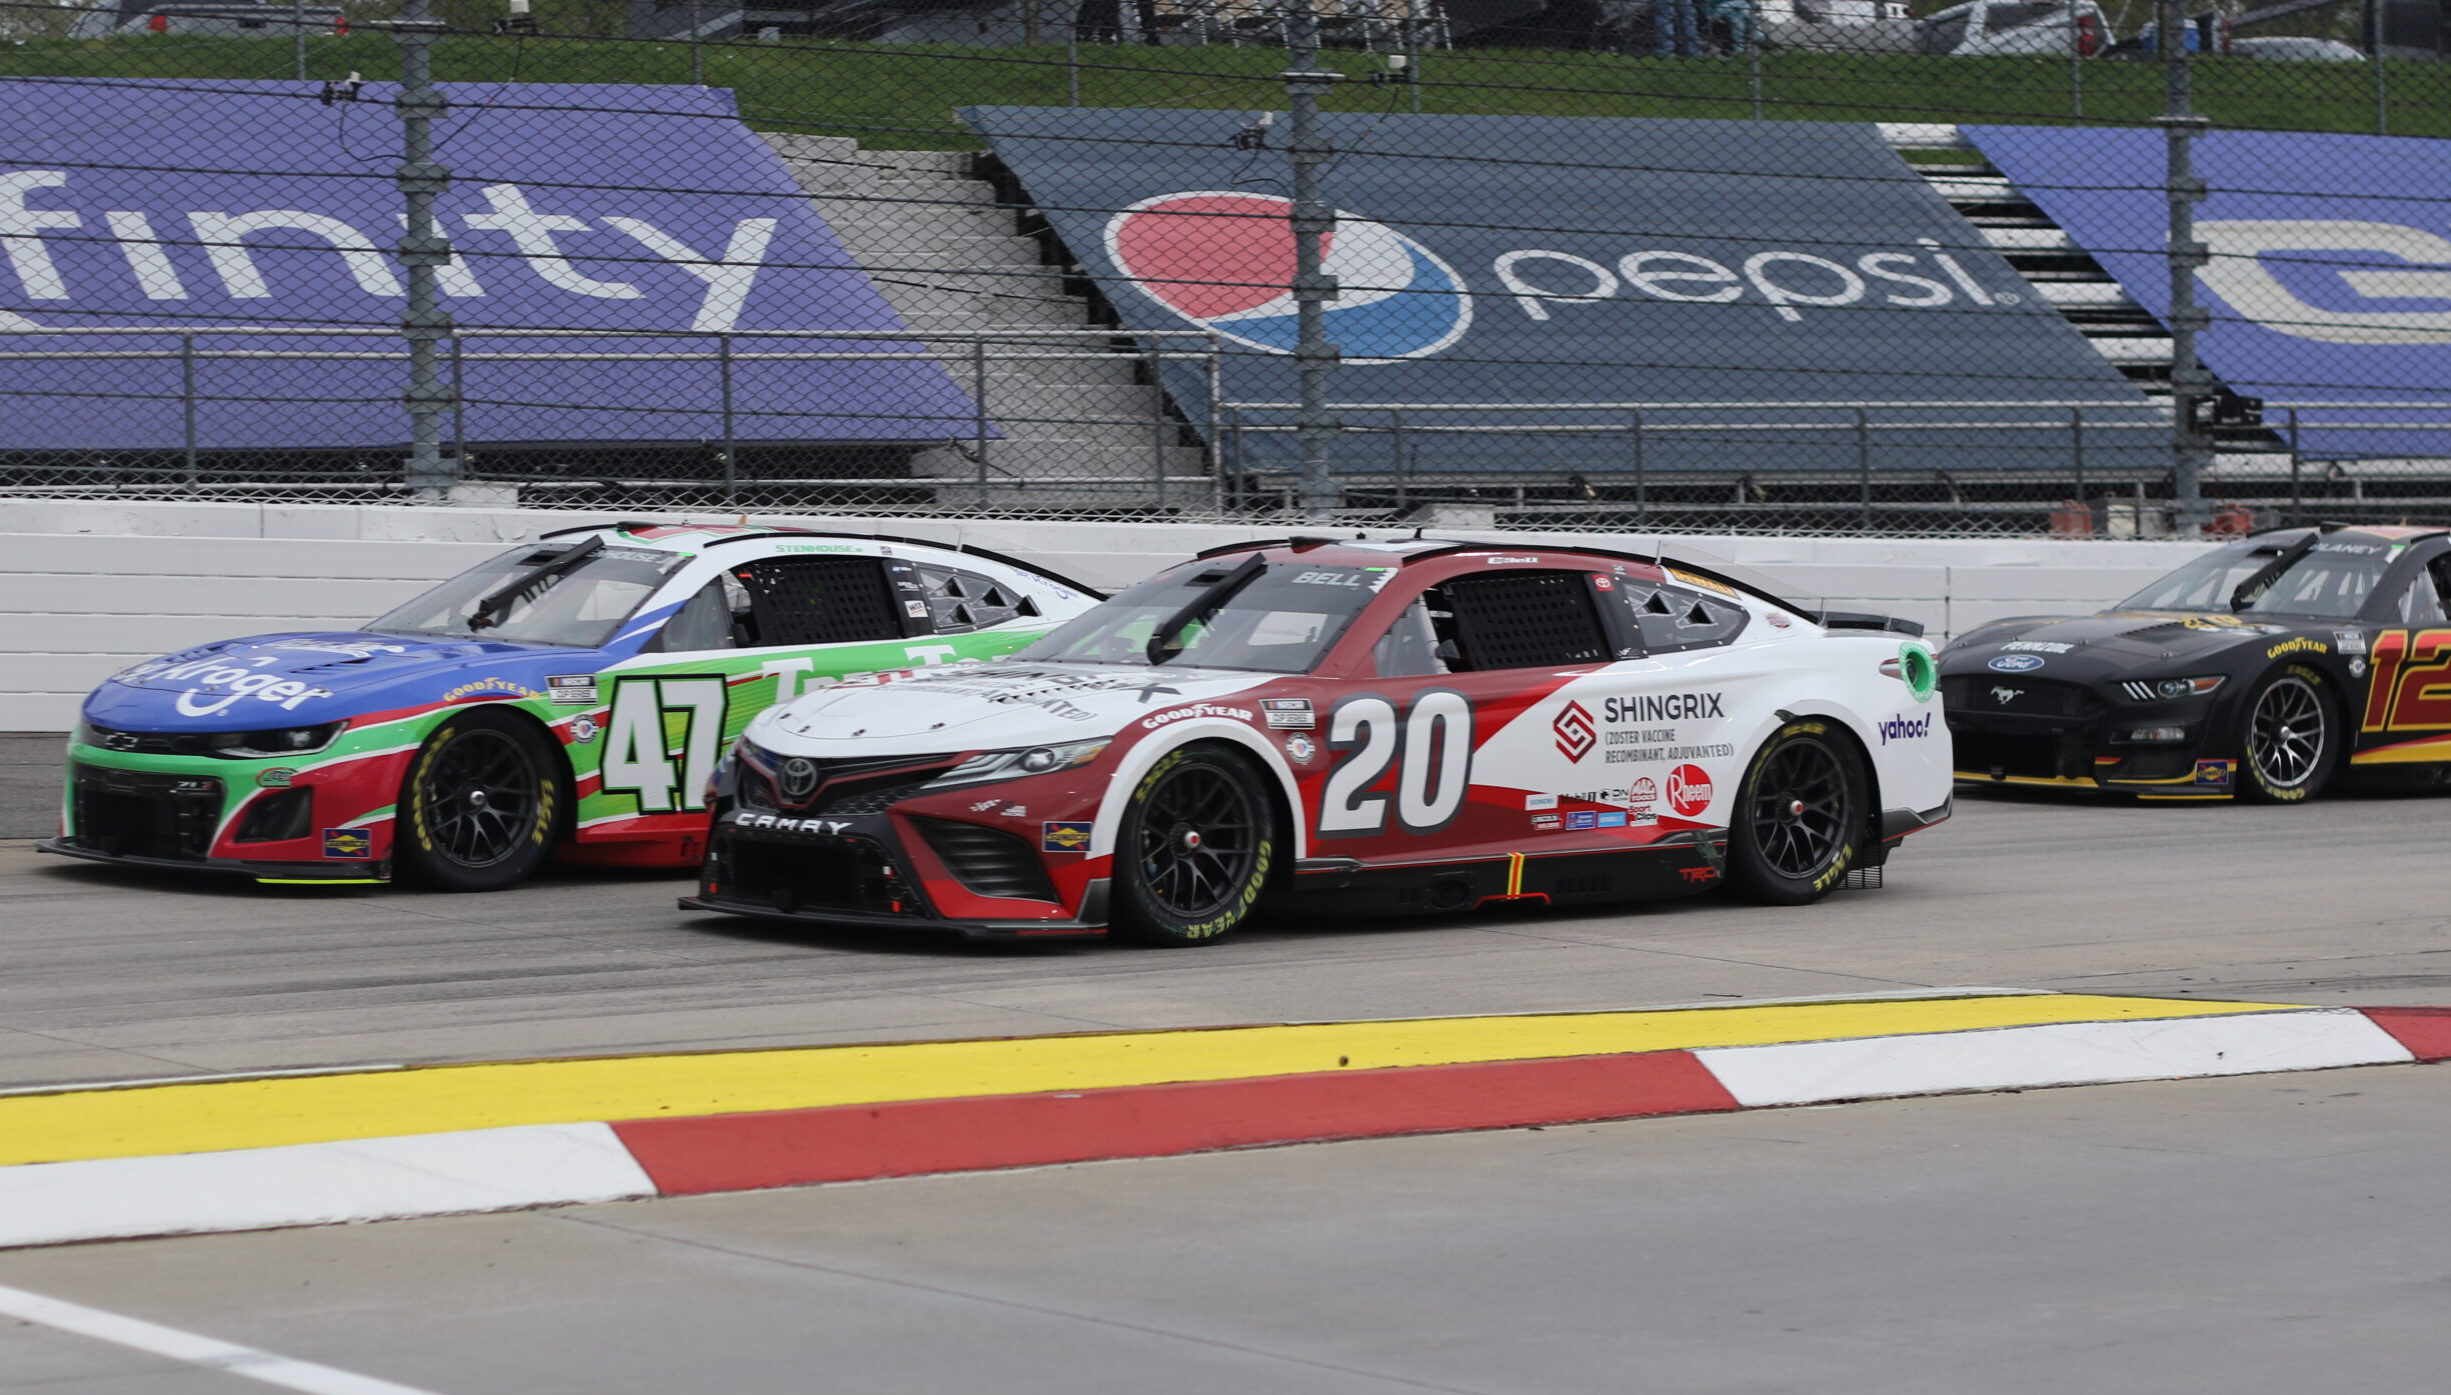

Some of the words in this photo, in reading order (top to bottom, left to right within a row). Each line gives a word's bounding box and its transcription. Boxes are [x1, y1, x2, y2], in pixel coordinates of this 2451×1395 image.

[0, 170, 778, 334] finity
[776, 544, 850, 553] STENHOUSE
[1291, 571, 1361, 587] BELL
[1996, 654, 2035, 669] Ford
[2267, 636, 2328, 659] GOODYEAR
[145, 654, 334, 717] Kroger
[443, 677, 541, 702] GOODYEAR
[2361, 629, 2451, 732] 12
[1142, 703, 1254, 729] GOODYEAR
[1604, 692, 1725, 723] SHINGRIX
[1605, 730, 1640, 746] (ZOSTER
[1641, 729, 1676, 744] VACCINE
[1878, 711, 1931, 746] yahoo!
[599, 673, 730, 815] 47
[1667, 743, 1735, 761] ADJUVANTED)
[1317, 688, 1475, 836] 20
[1668, 765, 1712, 810] Rheem
[735, 812, 853, 835] CAMRY
[1186, 840, 1272, 939] GOODYEAR
